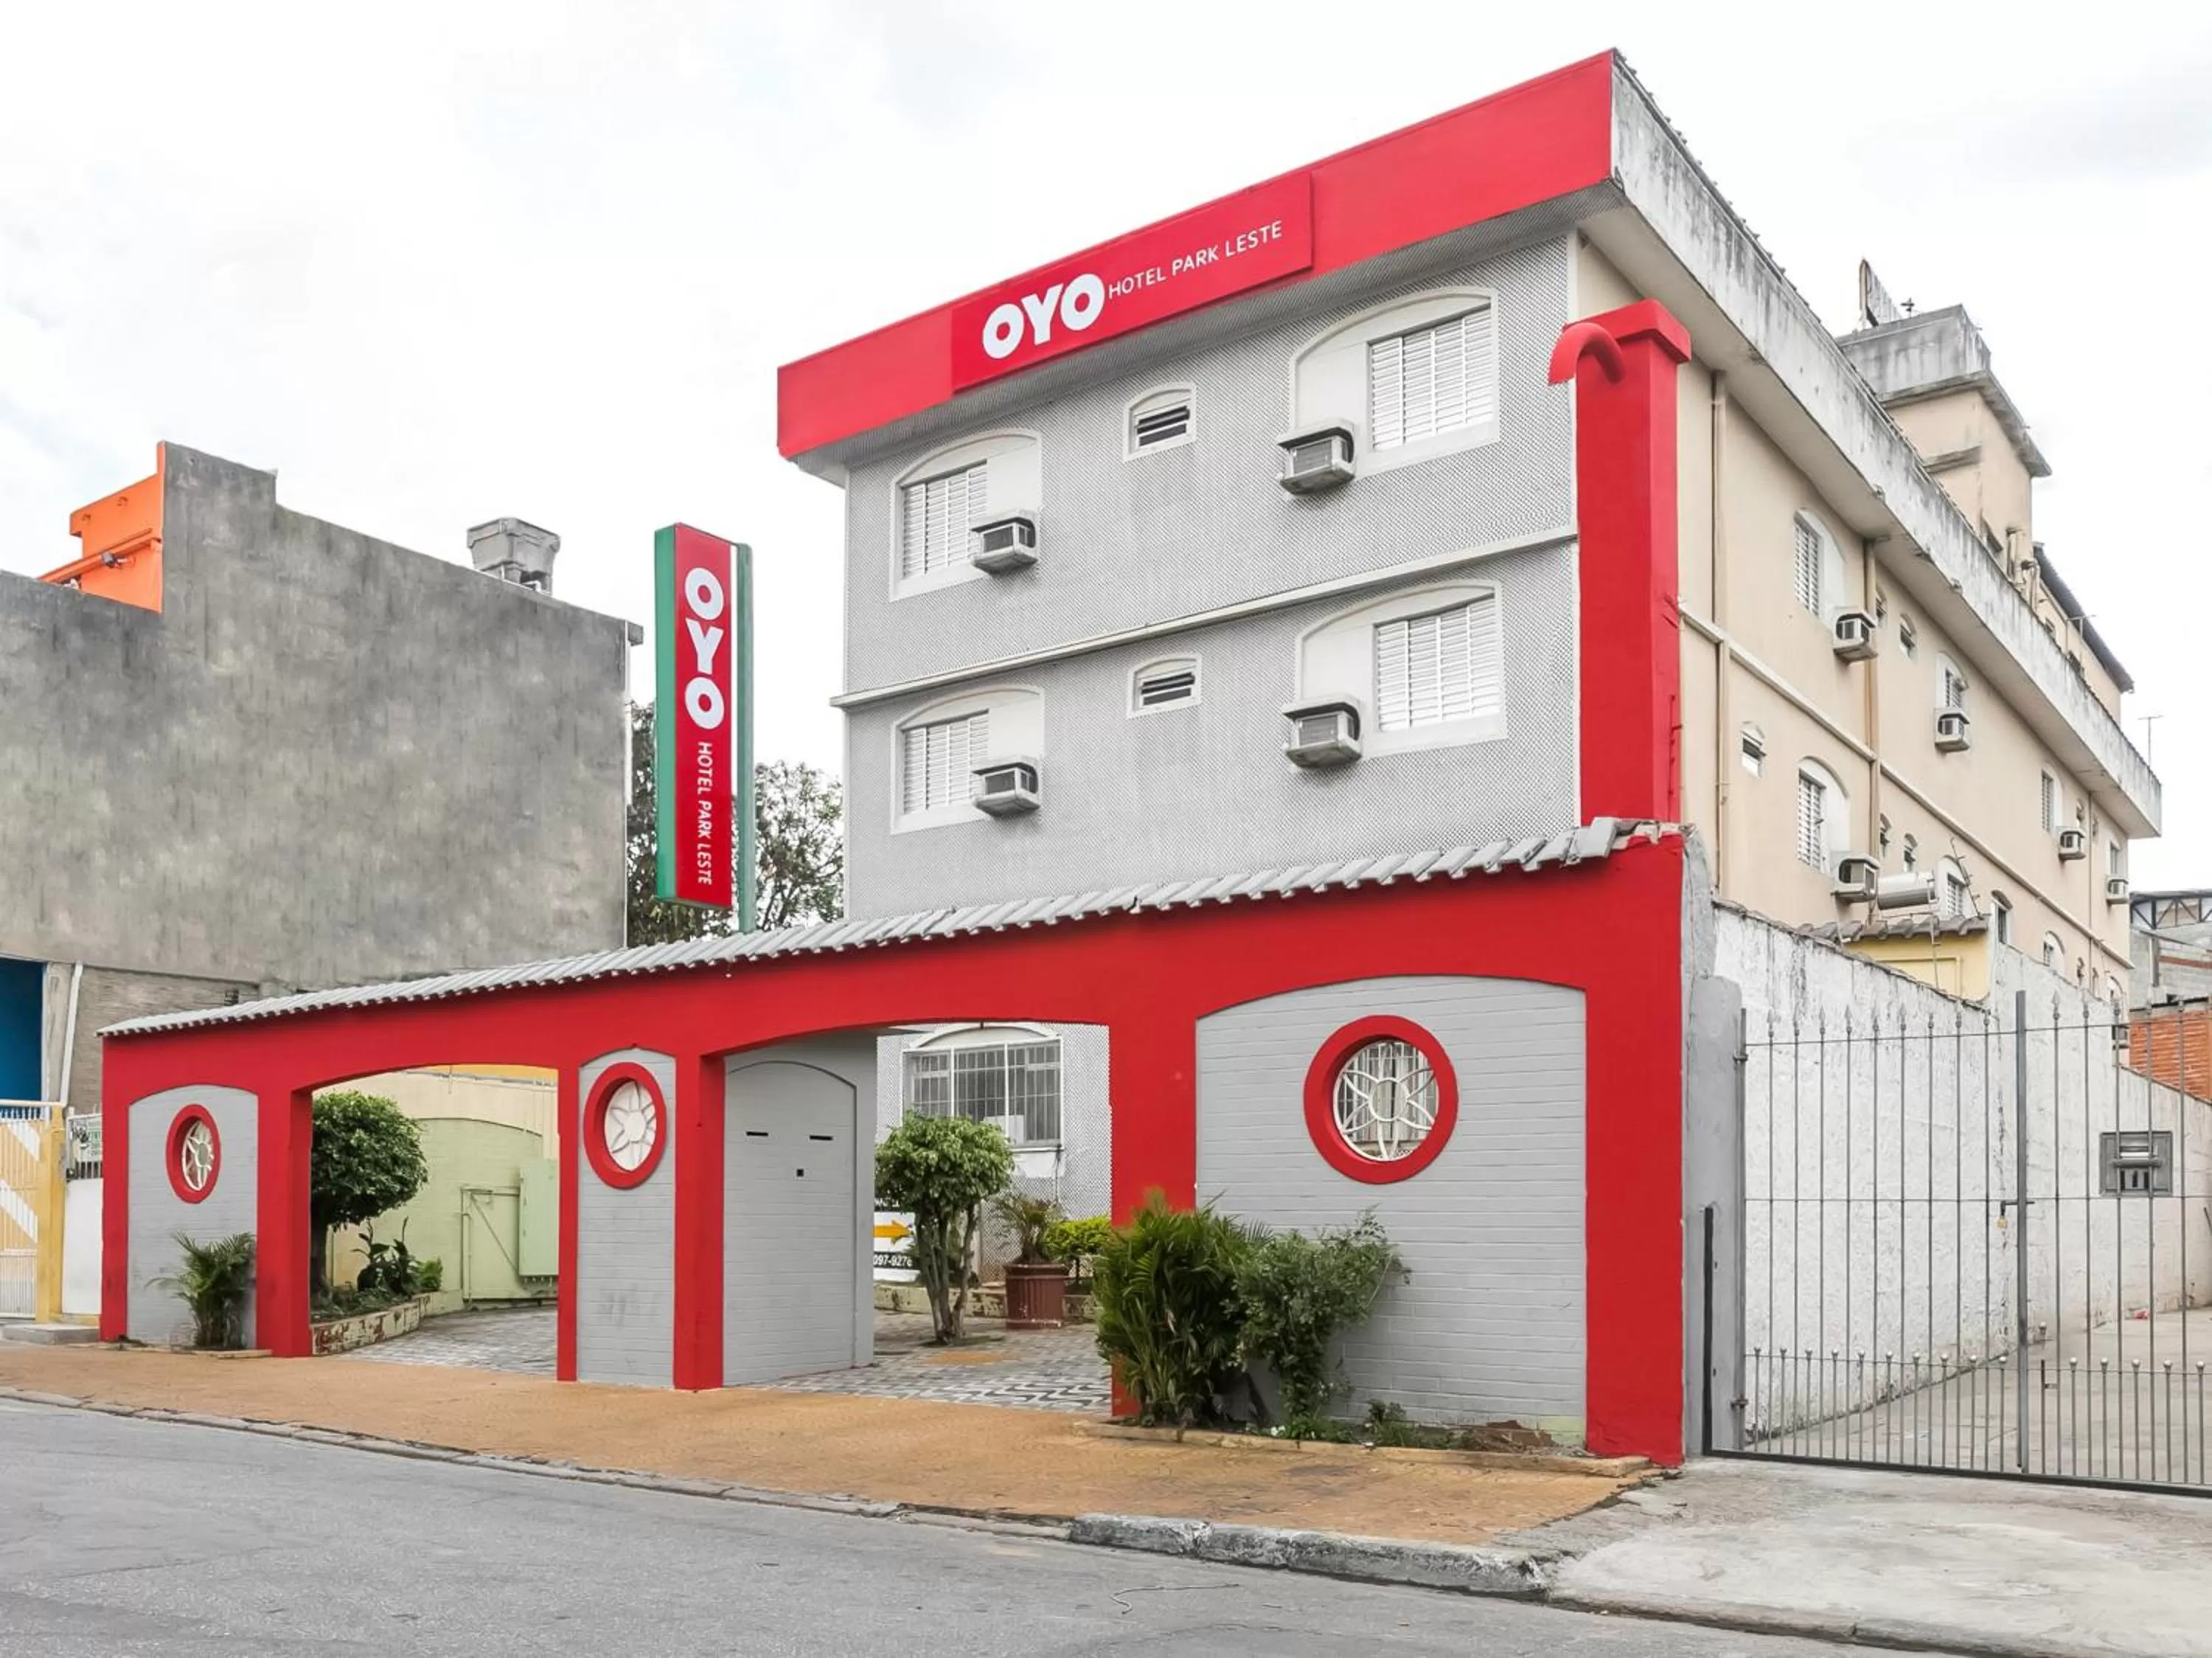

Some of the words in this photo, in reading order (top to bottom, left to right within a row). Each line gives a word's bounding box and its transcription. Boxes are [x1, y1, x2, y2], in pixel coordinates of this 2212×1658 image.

[982, 273, 1105, 359] OYO
[1108, 267, 1166, 299] HOTEL
[1172, 245, 1219, 277] PARK
[1225, 221, 1282, 257] LESTE
[684, 566, 725, 729] OYO
[697, 742, 713, 794] HOTEL
[697, 800, 713, 839] PARK
[697, 842, 713, 885] LESTE
